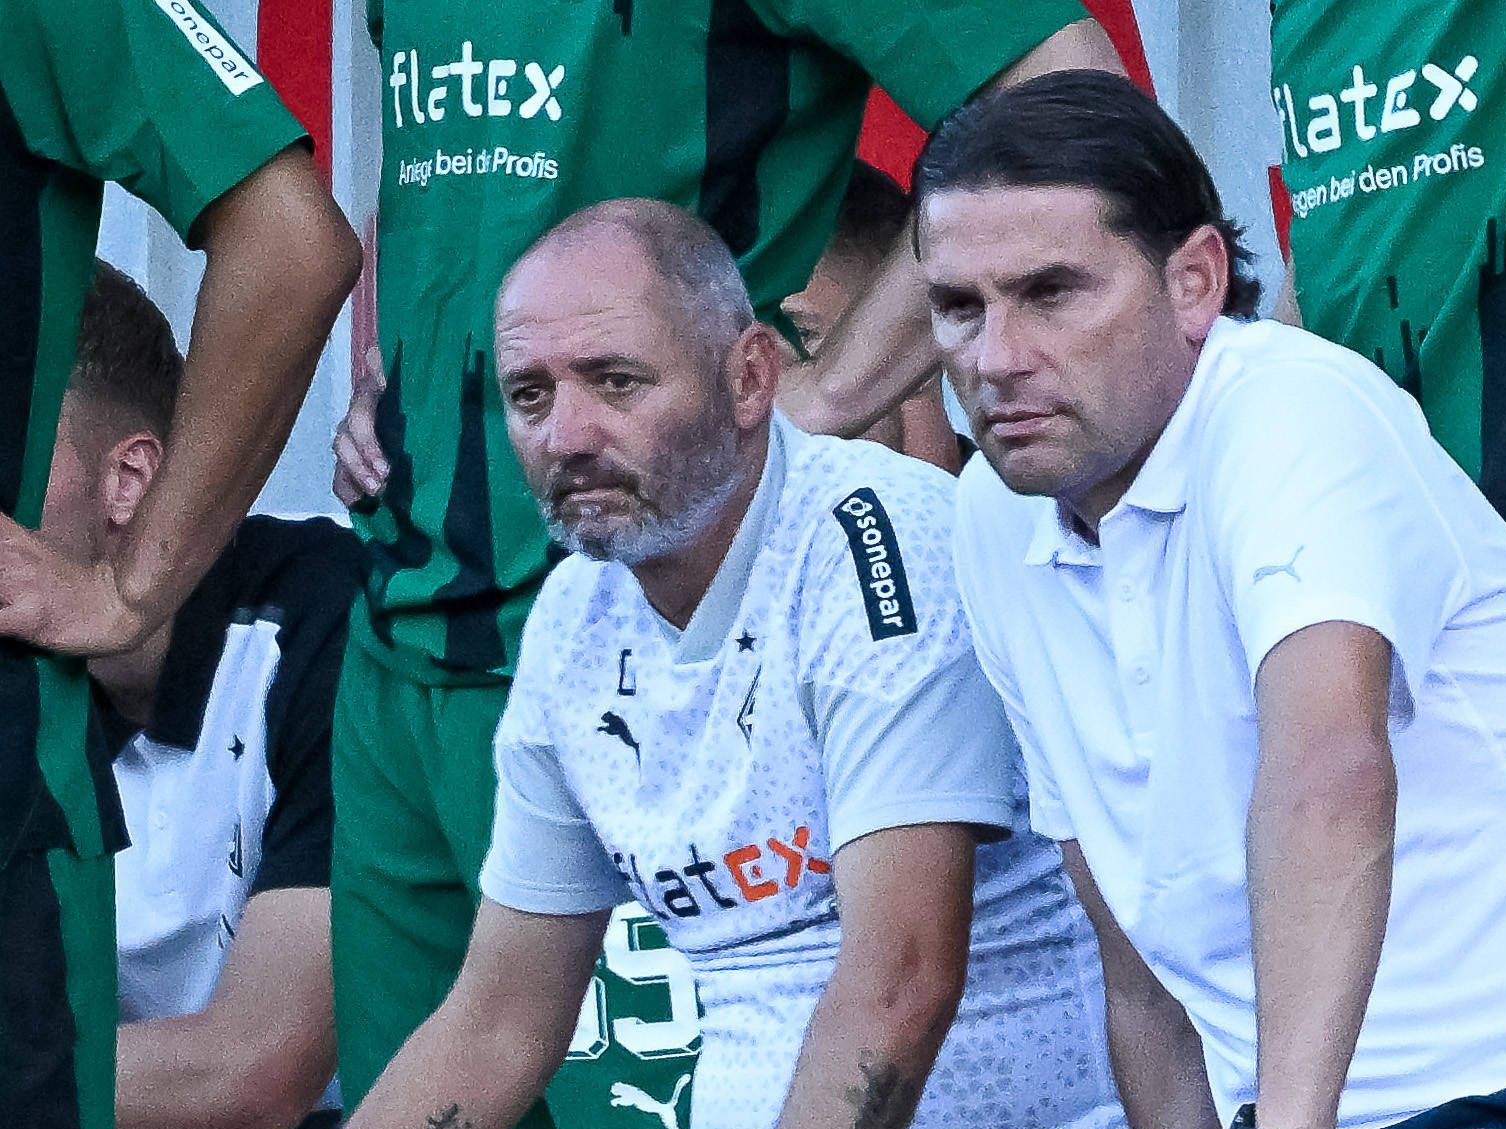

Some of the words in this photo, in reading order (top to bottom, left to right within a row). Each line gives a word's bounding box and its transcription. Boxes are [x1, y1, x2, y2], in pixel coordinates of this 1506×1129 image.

[435, 148, 473, 175] bei
[492, 147, 559, 179] Profis
[1330, 169, 1356, 202] bei
[1358, 164, 1408, 193] den
[1413, 143, 1485, 182] Profis
[856, 515, 905, 628] sonepar
